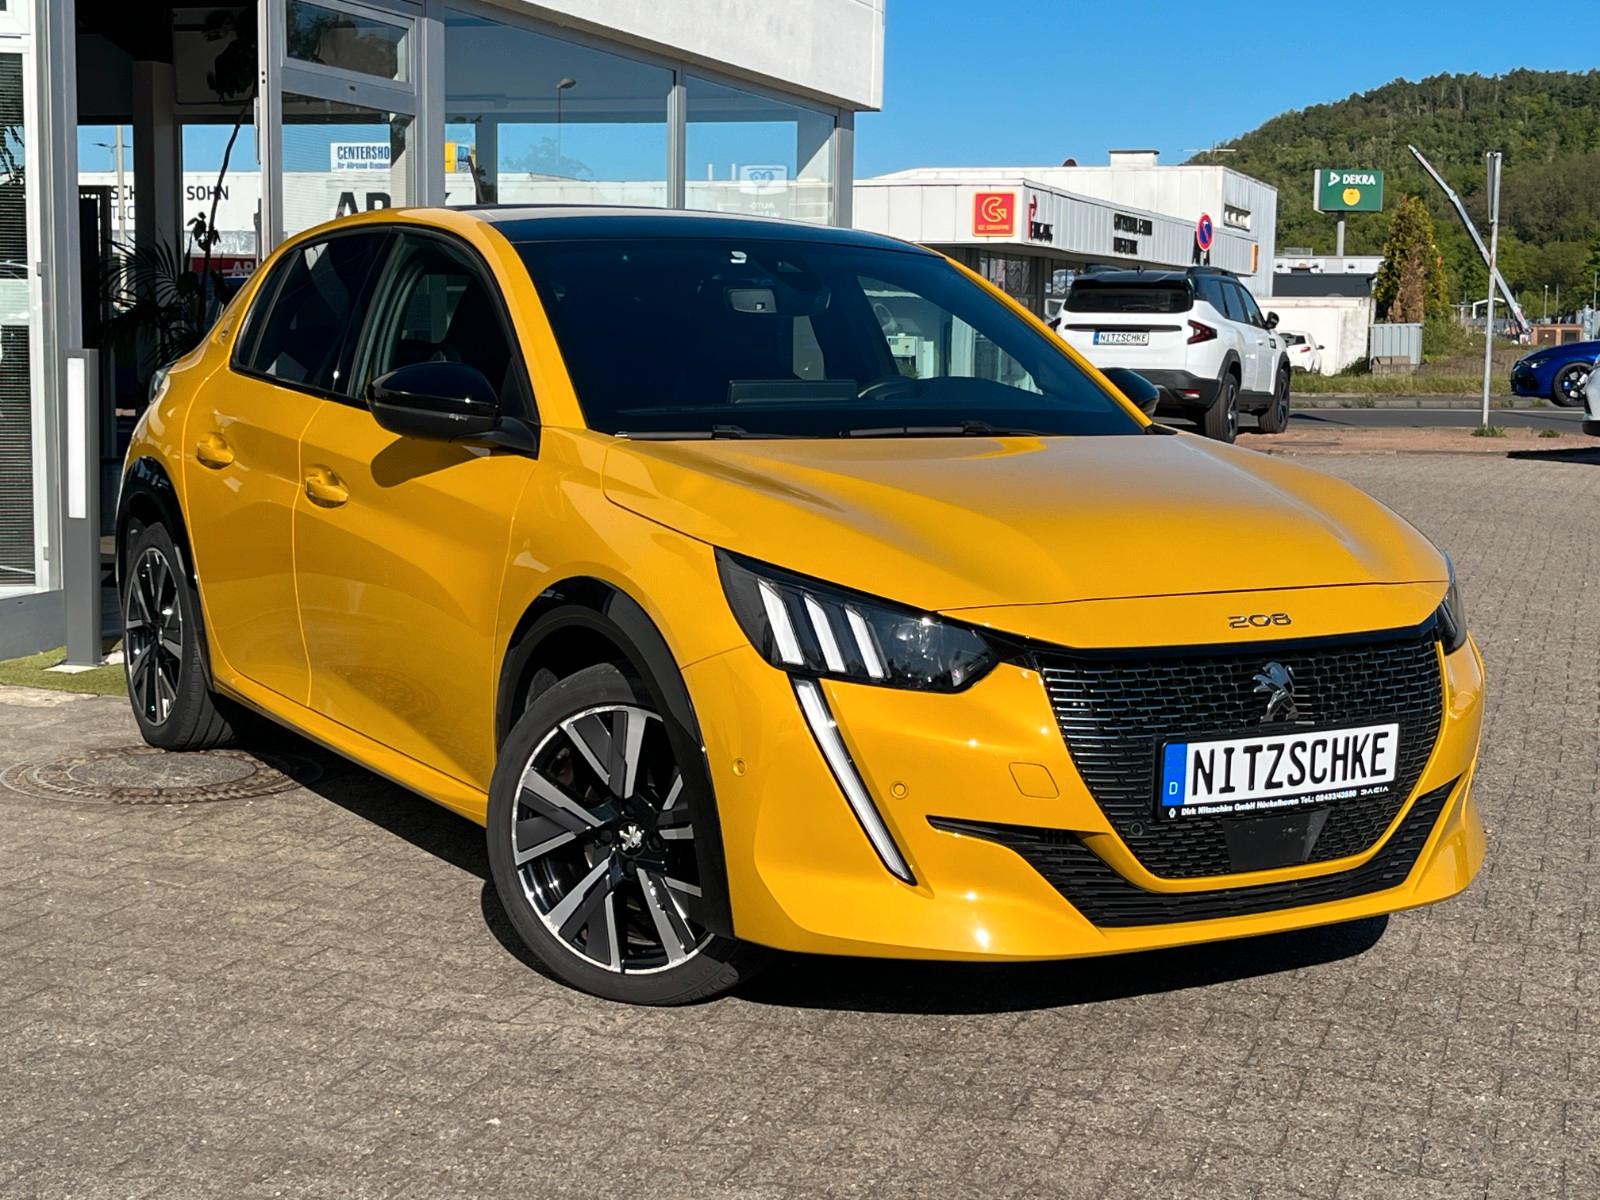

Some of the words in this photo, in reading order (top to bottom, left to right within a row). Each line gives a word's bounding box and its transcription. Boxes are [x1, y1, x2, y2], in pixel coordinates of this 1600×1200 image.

[1342, 174, 1376, 185] DEKRA
[186, 185, 229, 201] SOHN
[1100, 333, 1147, 343] NITZSCHKE
[1228, 613, 1292, 629] 208
[1169, 781, 1178, 795] D
[1192, 731, 1389, 796] NITZSCHKE
